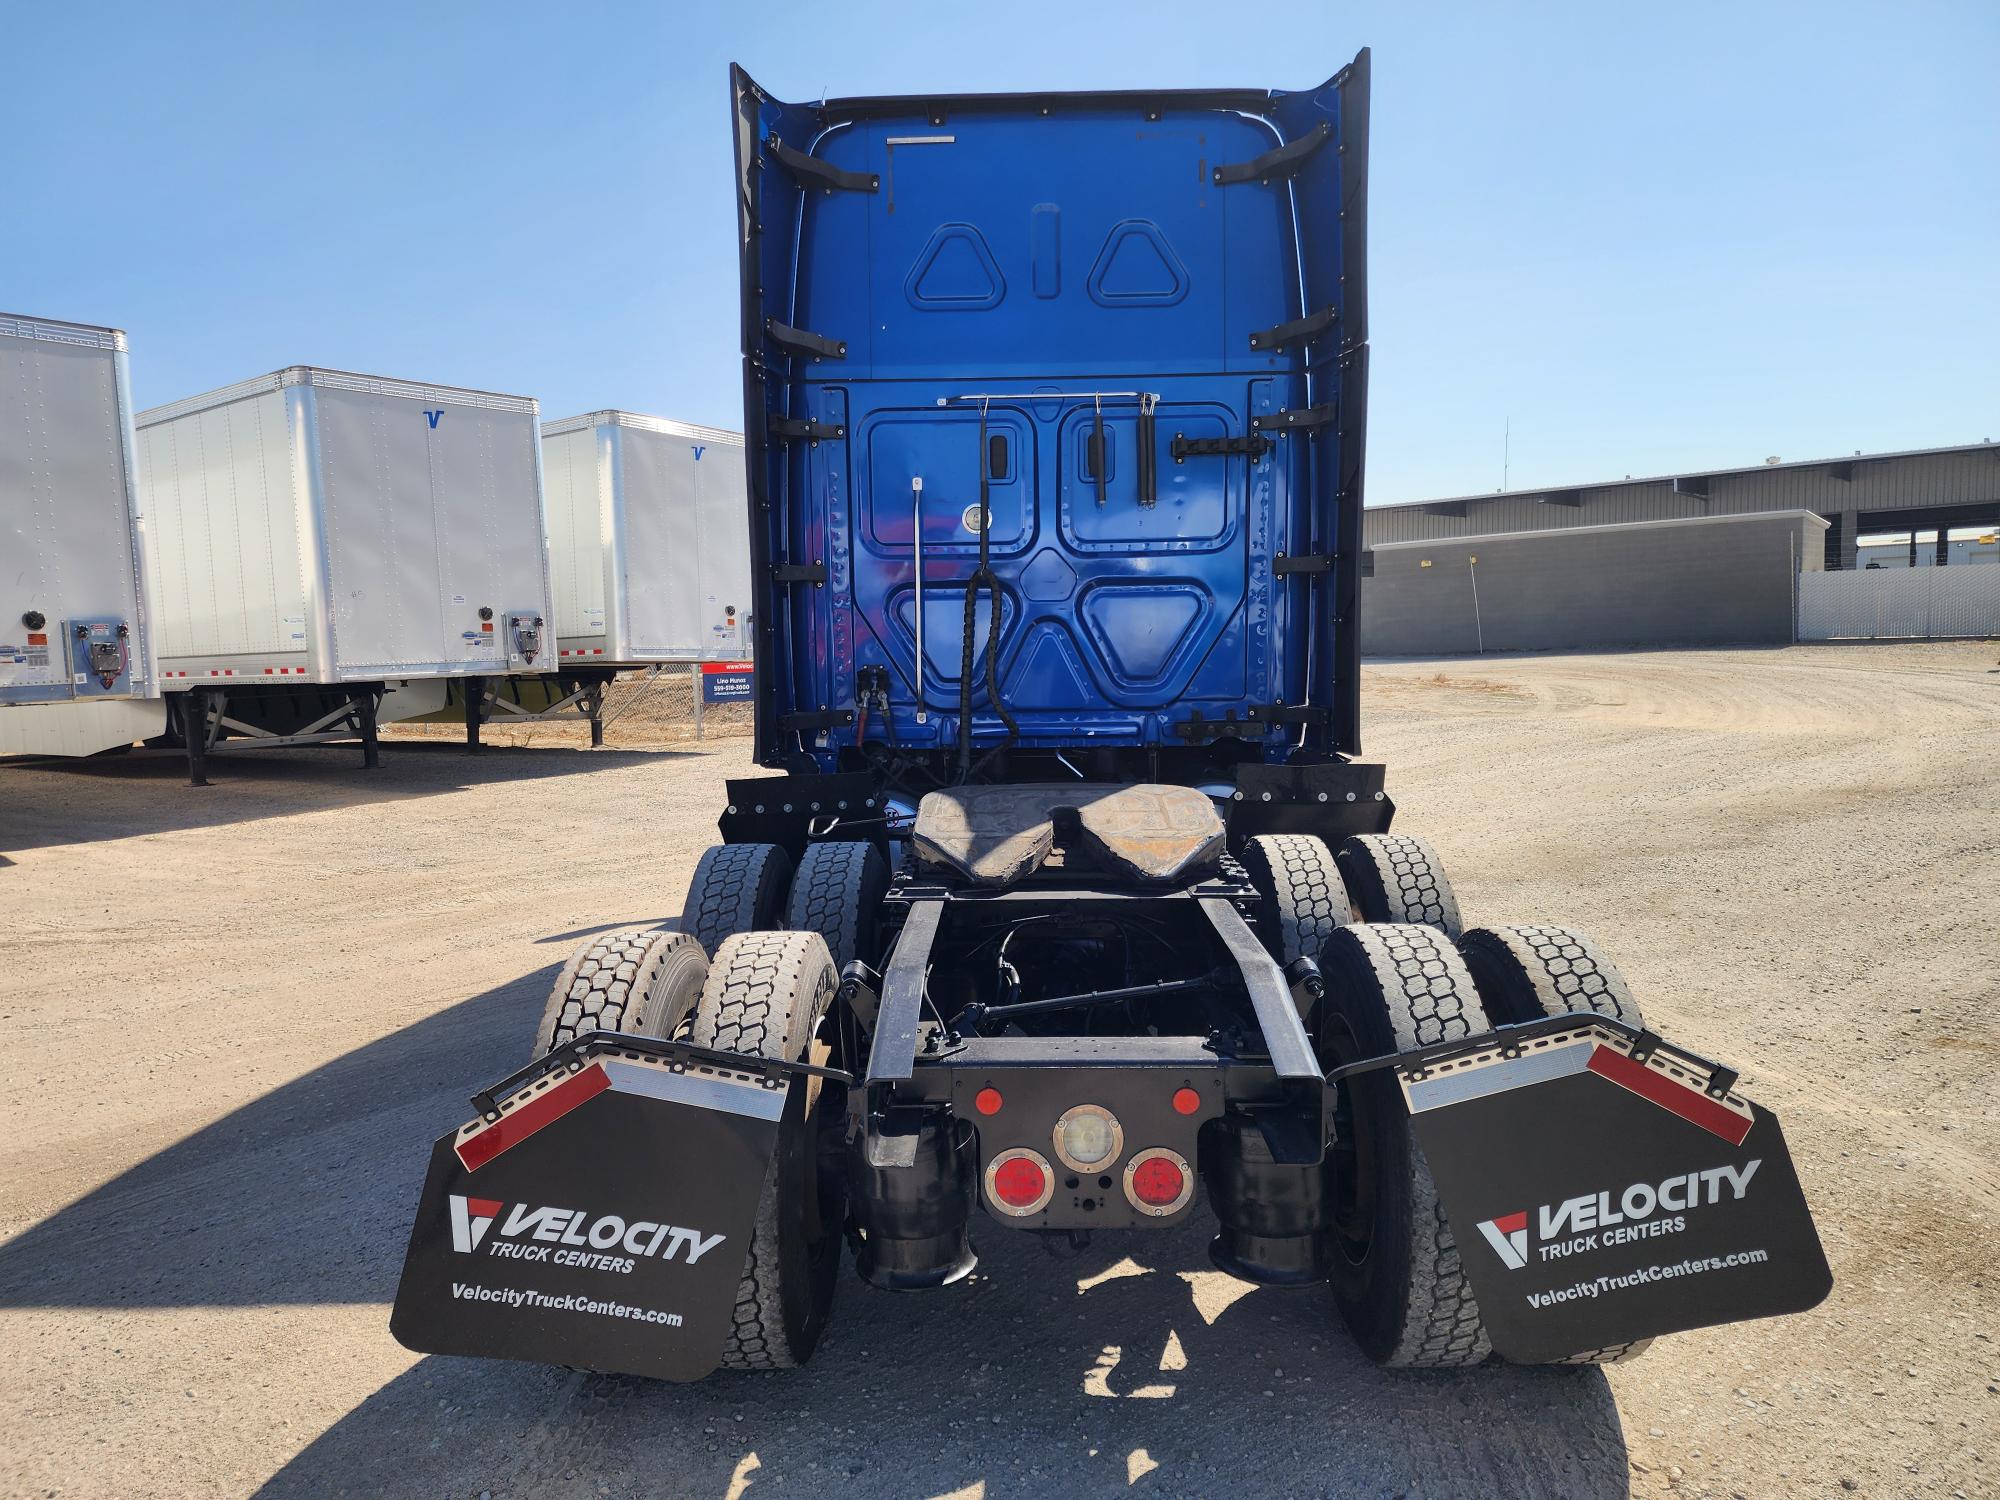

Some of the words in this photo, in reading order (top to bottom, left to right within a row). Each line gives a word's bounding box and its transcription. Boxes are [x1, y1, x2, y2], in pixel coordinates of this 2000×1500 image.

[1538, 1159, 1762, 1241] VELOCITY
[489, 1241, 552, 1263] TRUCK
[553, 1249, 636, 1275] CENTERS
[500, 1203, 727, 1266] VELOCITY
[1538, 1235, 1599, 1263] TRUCK
[1602, 1216, 1687, 1247] CENTERS
[452, 1282, 684, 1328] VelocityTruckCenters.com
[1526, 1247, 1769, 1310] VelocityTruckCenters.com
